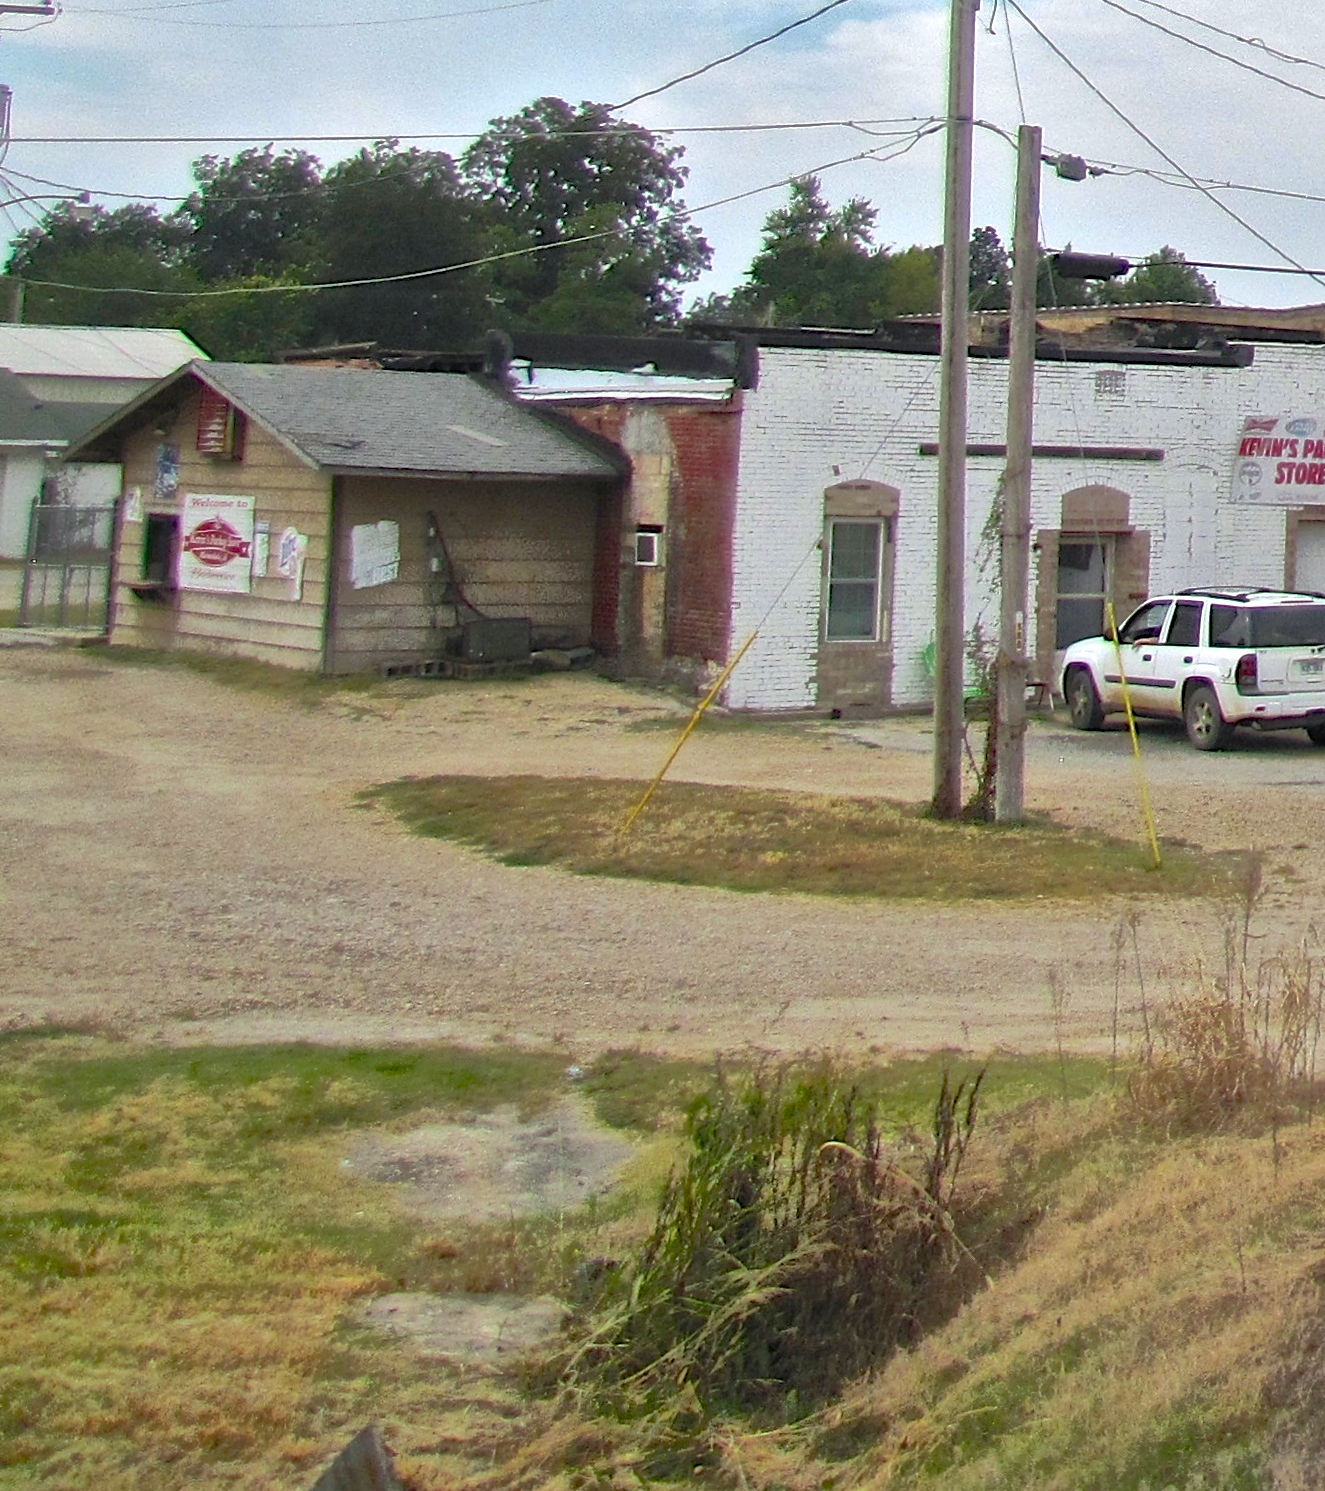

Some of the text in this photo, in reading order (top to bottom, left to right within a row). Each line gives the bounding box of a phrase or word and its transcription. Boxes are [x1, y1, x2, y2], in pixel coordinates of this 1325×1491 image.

[1238, 437, 1299, 458] KEVIN'S
[191, 497, 249, 508] Welcome to
